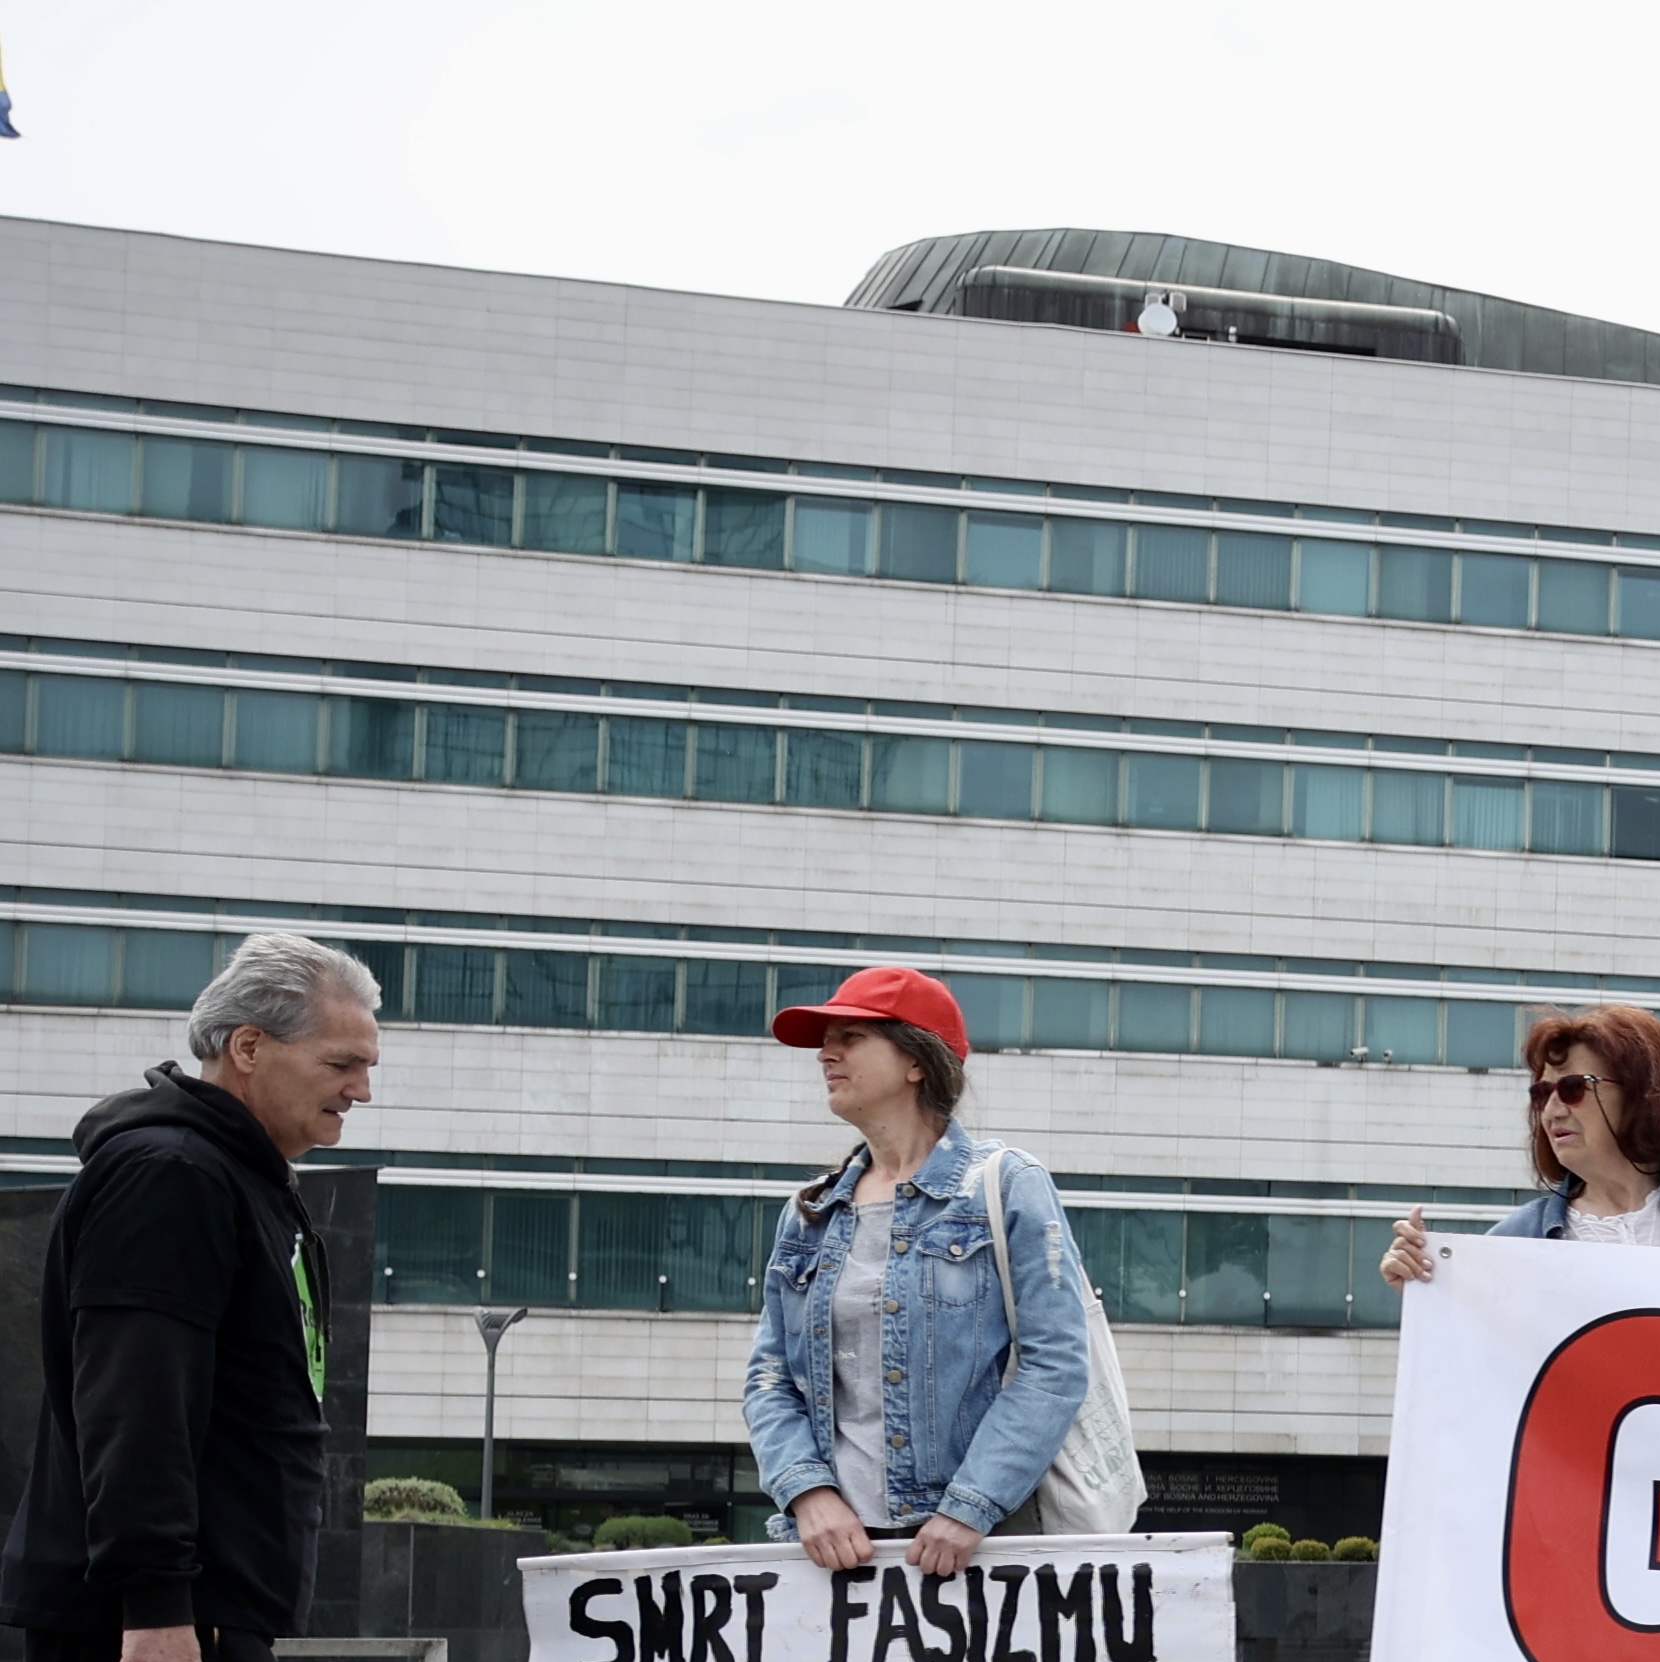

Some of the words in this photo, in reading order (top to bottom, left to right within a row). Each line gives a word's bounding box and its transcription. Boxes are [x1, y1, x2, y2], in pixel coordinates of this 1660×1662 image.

[1168, 1474, 1199, 1483] BOSNE
[1215, 1475, 1279, 1485] HERCEGOVINE
[1163, 1492, 1197, 1501] BOSNIA
[1197, 1493, 1216, 1502] AND
[1217, 1493, 1280, 1503] HERZEGOVINA
